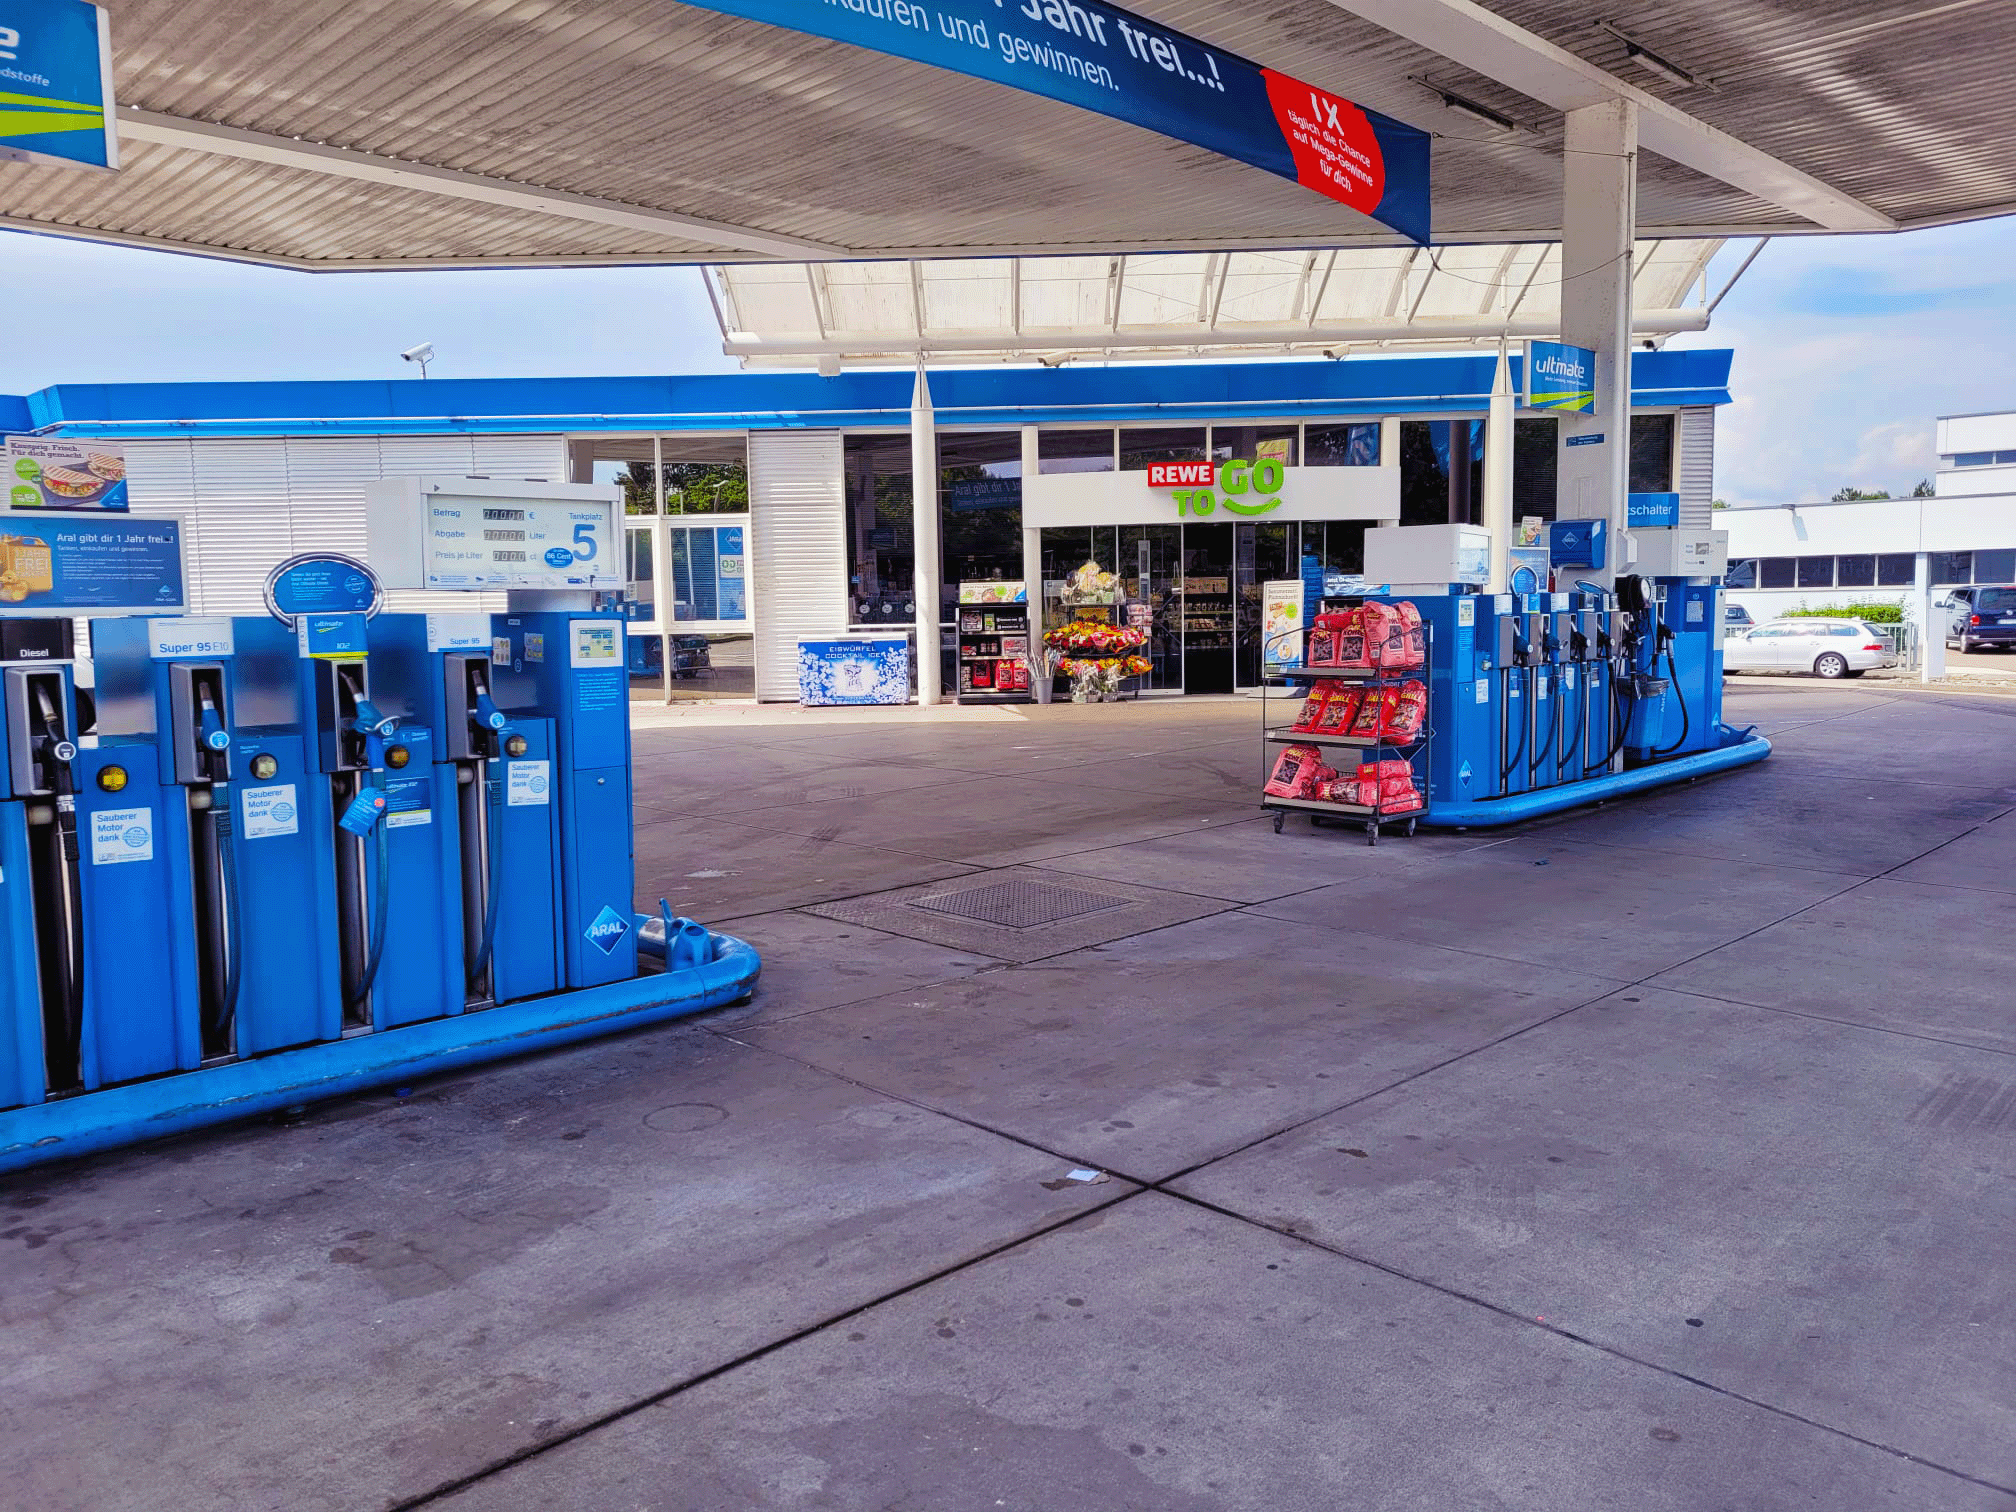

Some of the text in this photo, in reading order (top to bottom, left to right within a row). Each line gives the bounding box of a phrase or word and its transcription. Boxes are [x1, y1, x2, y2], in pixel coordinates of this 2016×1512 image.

[937, 12, 990, 50] und
[998, 32, 1120, 91] gewinnen.
[1287, 108, 1371, 168] täglich die Chance
[1292, 128, 1374, 187] auf Mega-Gewinne
[1319, 158, 1333, 177] für
[1535, 355, 1585, 379] ultimate
[1151, 465, 1211, 483] REWE
[1220, 458, 1285, 495] GO
[1172, 489, 1216, 517] TO
[433, 508, 461, 518] Betrag
[568, 512, 603, 521] Tankplatz
[57, 533, 76, 542] Aral
[79, 533, 98, 543] gibt
[101, 534, 114, 542] dir
[116, 534, 121, 542] 1
[124, 534, 145, 543] Jahr
[435, 530, 465, 539] Abgabe
[573, 523, 597, 561] 5
[435, 551, 456, 559] Preis
[466, 551, 483, 559] Liter
[20, 648, 49, 658] Diesel
[159, 641, 229, 654] Super 95 E10
[247, 789, 284, 799] Sauberer
[248, 799, 273, 809] Motor
[96, 812, 137, 823] Sauberer
[248, 809, 268, 818] dank
[97, 823, 124, 833] Motor
[97, 833, 120, 843] dank
[591, 921, 624, 938] ARAL
